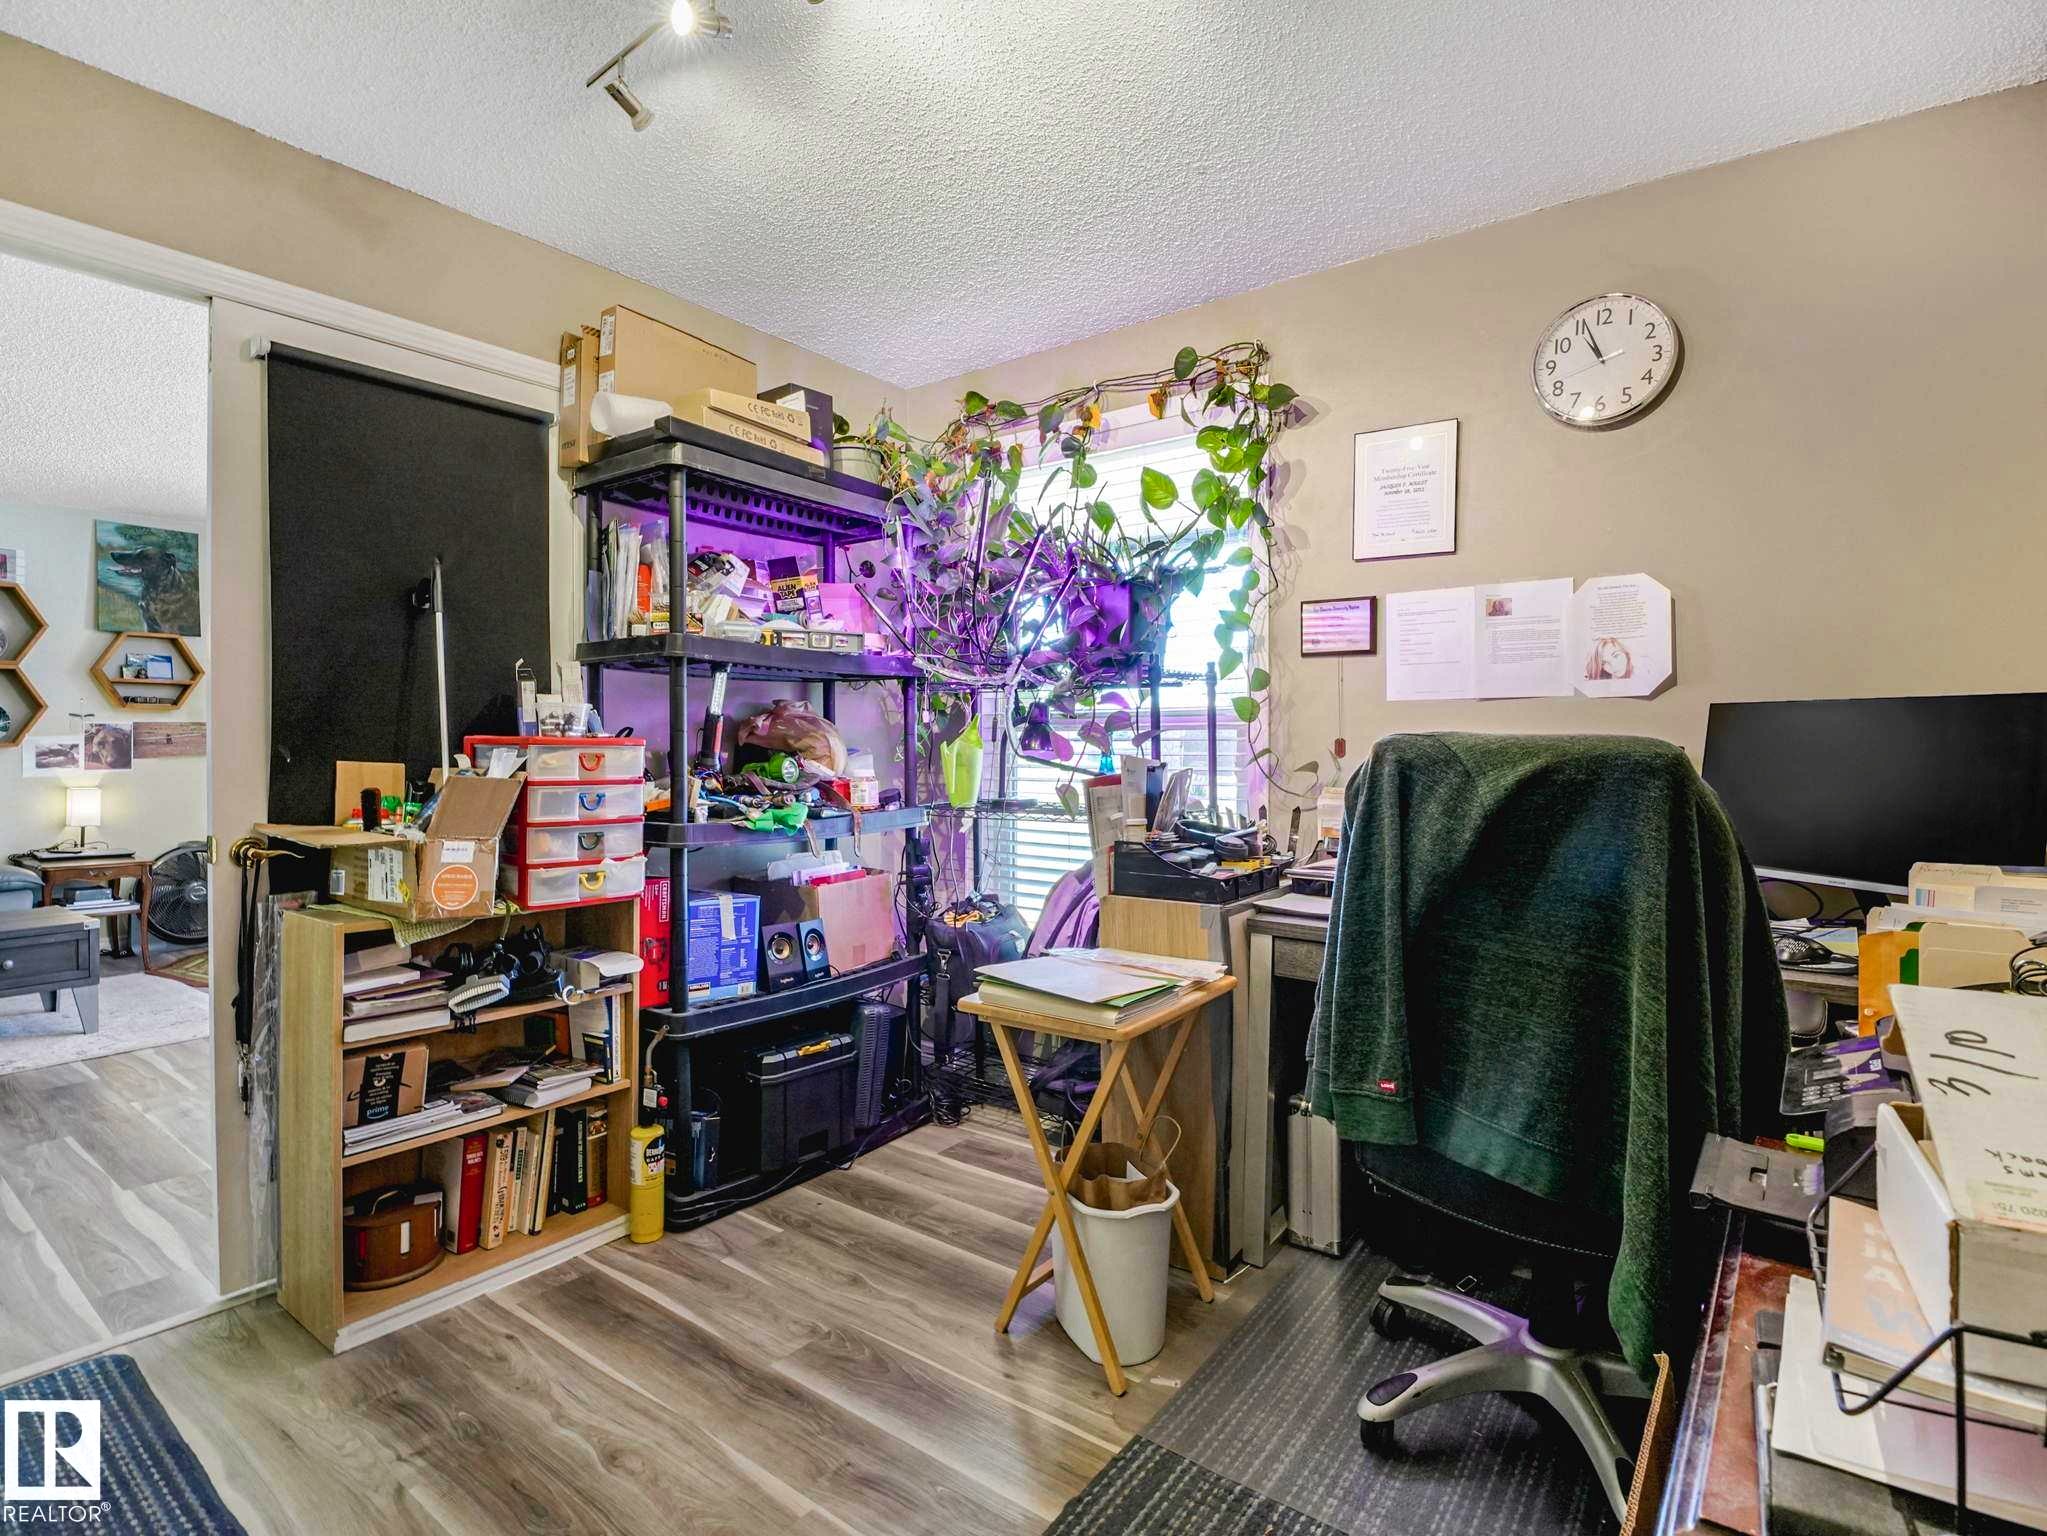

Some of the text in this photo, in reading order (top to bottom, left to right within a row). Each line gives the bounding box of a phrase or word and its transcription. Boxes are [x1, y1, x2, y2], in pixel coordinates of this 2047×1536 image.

[1596, 308, 1613, 326] 12
[1629, 308, 1633, 326] 1
[1575, 318, 1586, 336] 11
[1644, 322, 1656, 340] 2
[1554, 337, 1572, 355] 10
[1651, 344, 1663, 362] 3
[1545, 360, 1557, 376] 9
[1640, 368, 1654, 385] 4
[1552, 380, 1564, 397] 8
[1620, 386, 1632, 404] 5
[1570, 391, 1582, 409] 7
[1594, 395, 1606, 412] 6
[777, 583, 797, 591] ALIEN
[367, 1105, 389, 1115] prime
